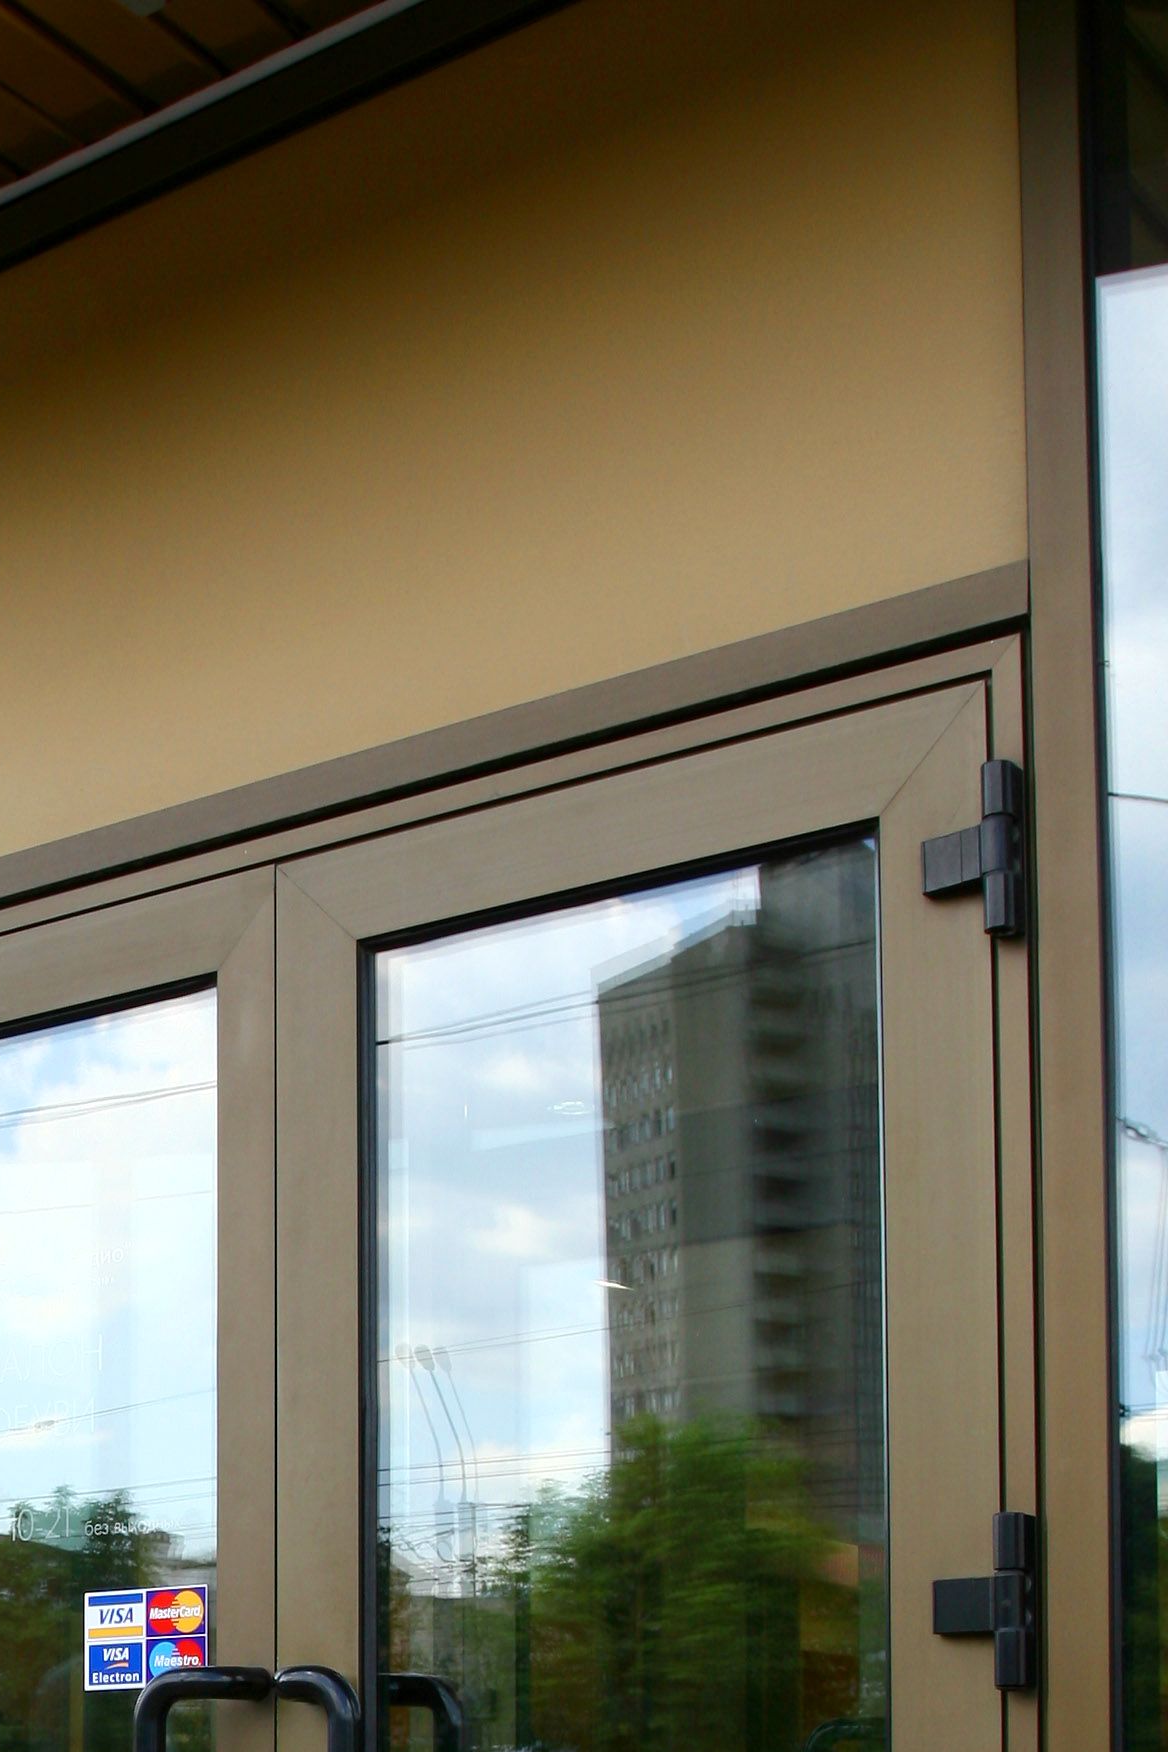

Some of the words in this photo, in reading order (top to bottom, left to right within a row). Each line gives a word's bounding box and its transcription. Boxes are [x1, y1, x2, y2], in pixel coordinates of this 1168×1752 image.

[84, 1519, 109, 1537] без
[99, 1607, 134, 1625] VISA
[149, 1606, 201, 1620] MasterCard
[103, 1647, 129, 1661] VISA
[92, 1672, 140, 1684] Electron
